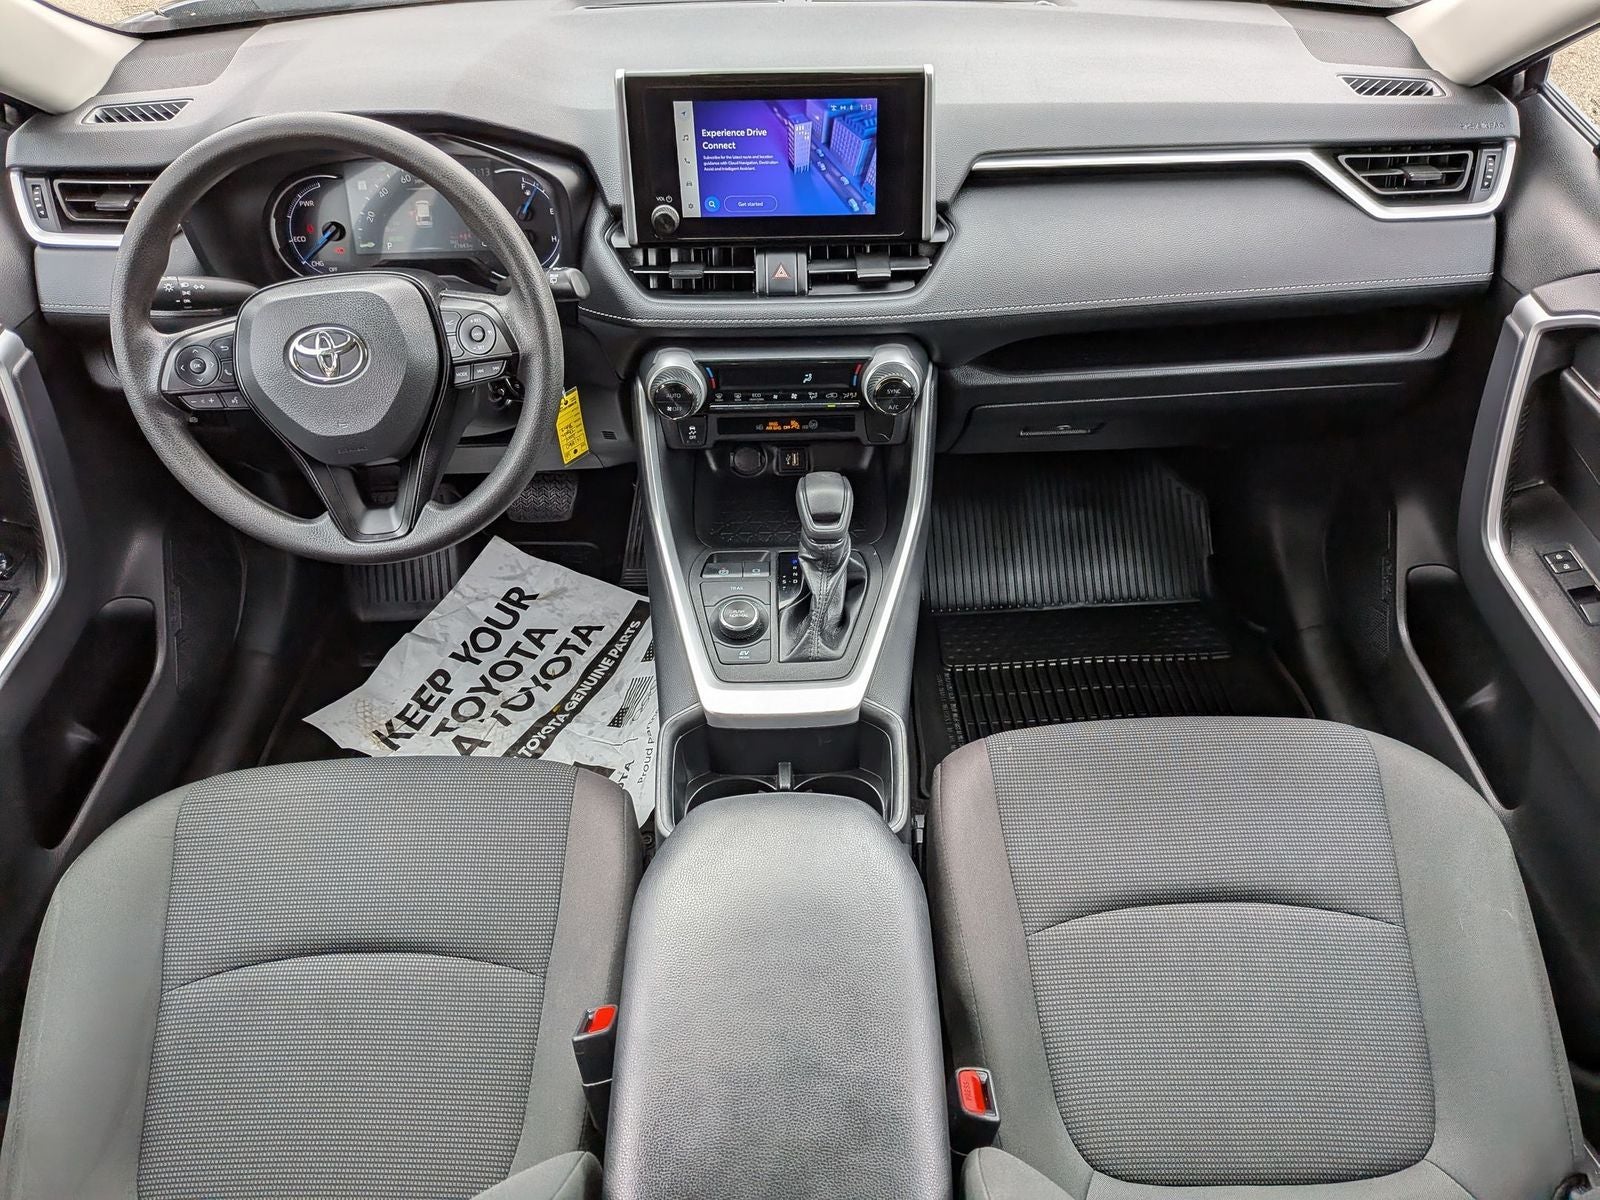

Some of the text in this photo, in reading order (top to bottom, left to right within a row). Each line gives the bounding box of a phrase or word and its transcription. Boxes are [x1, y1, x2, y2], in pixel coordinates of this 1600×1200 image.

[701, 128, 768, 139] Experience Drive
[702, 141, 737, 150] Connect
[400, 174, 412, 184] 60
[379, 187, 389, 198] 40
[366, 210, 376, 223] 20
[386, 242, 393, 250] P
[372, 586, 540, 752] KEEP YOUR
[429, 628, 559, 737] TOYOTA
[517, 620, 642, 758] TOYOTA GENUINE PARTS
[451, 735, 492, 757] A
[478, 625, 606, 728] TOYOTA
[637, 747, 654, 784] Proud
